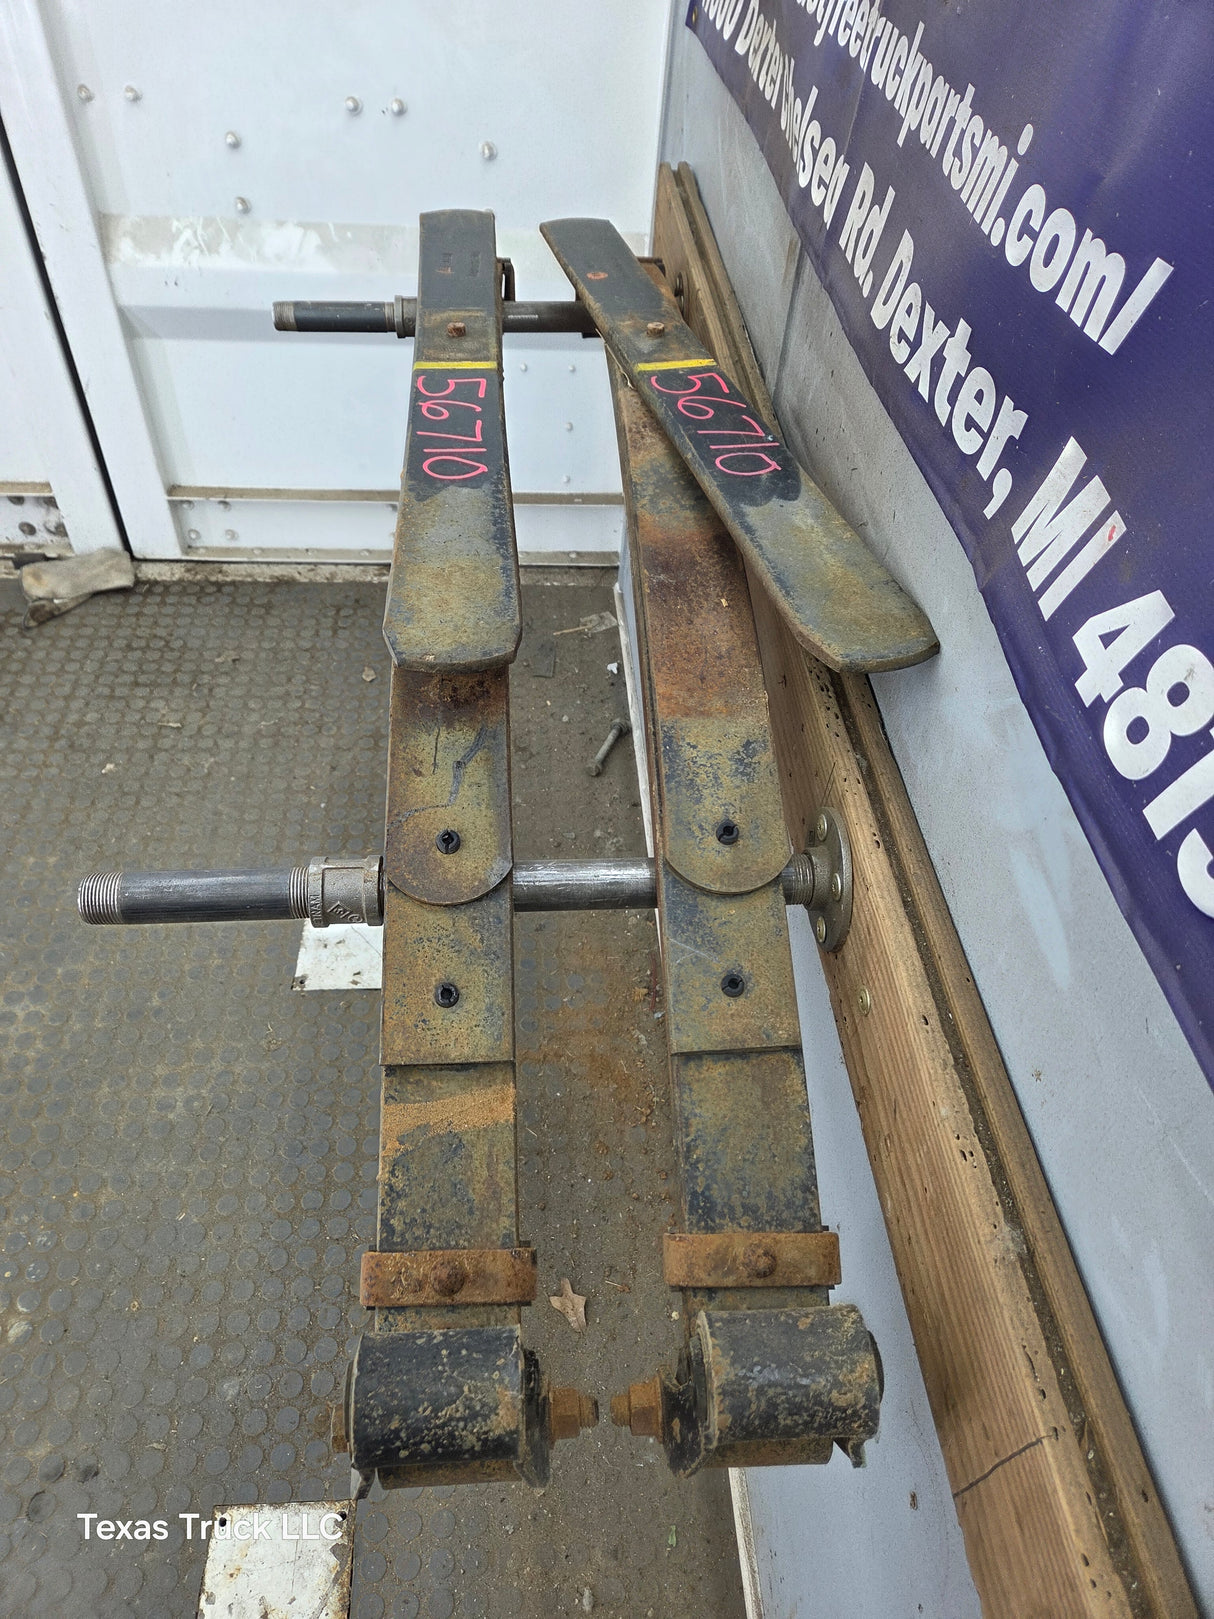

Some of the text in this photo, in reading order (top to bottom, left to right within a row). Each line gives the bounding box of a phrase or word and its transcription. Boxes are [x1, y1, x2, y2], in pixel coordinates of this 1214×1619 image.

[735, 0, 783, 111] Dexter
[839, 162, 896, 298] Rd.
[870, 228, 1028, 520] Dexter,
[1011, 436, 1127, 621] MI
[416, 375, 488, 480] 56710
[650, 372, 782, 476] 56710
